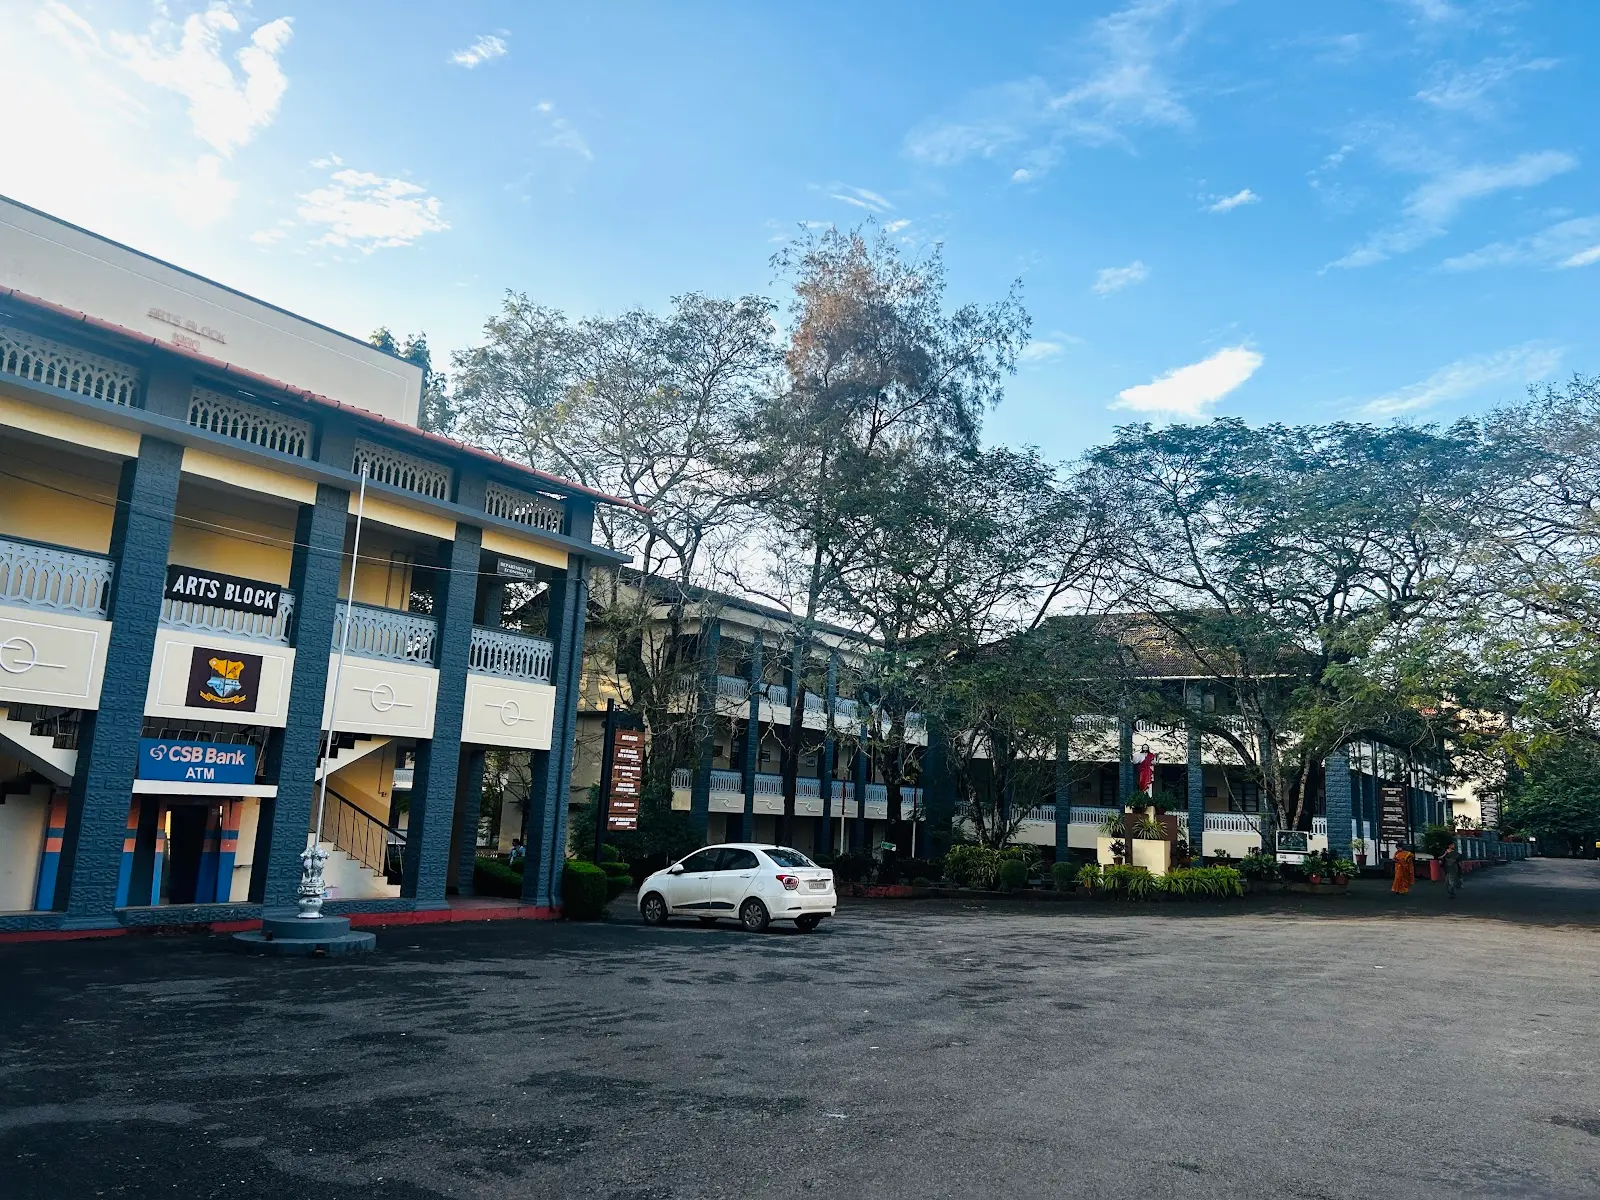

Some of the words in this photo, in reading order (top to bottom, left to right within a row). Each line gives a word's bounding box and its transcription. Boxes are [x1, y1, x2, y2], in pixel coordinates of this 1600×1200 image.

[172, 574, 220, 599] ARTS
[223, 582, 277, 610] BLOCK
[168, 745, 203, 763] CSB
[204, 747, 247, 766] Bank
[185, 766, 215, 780] ATM
